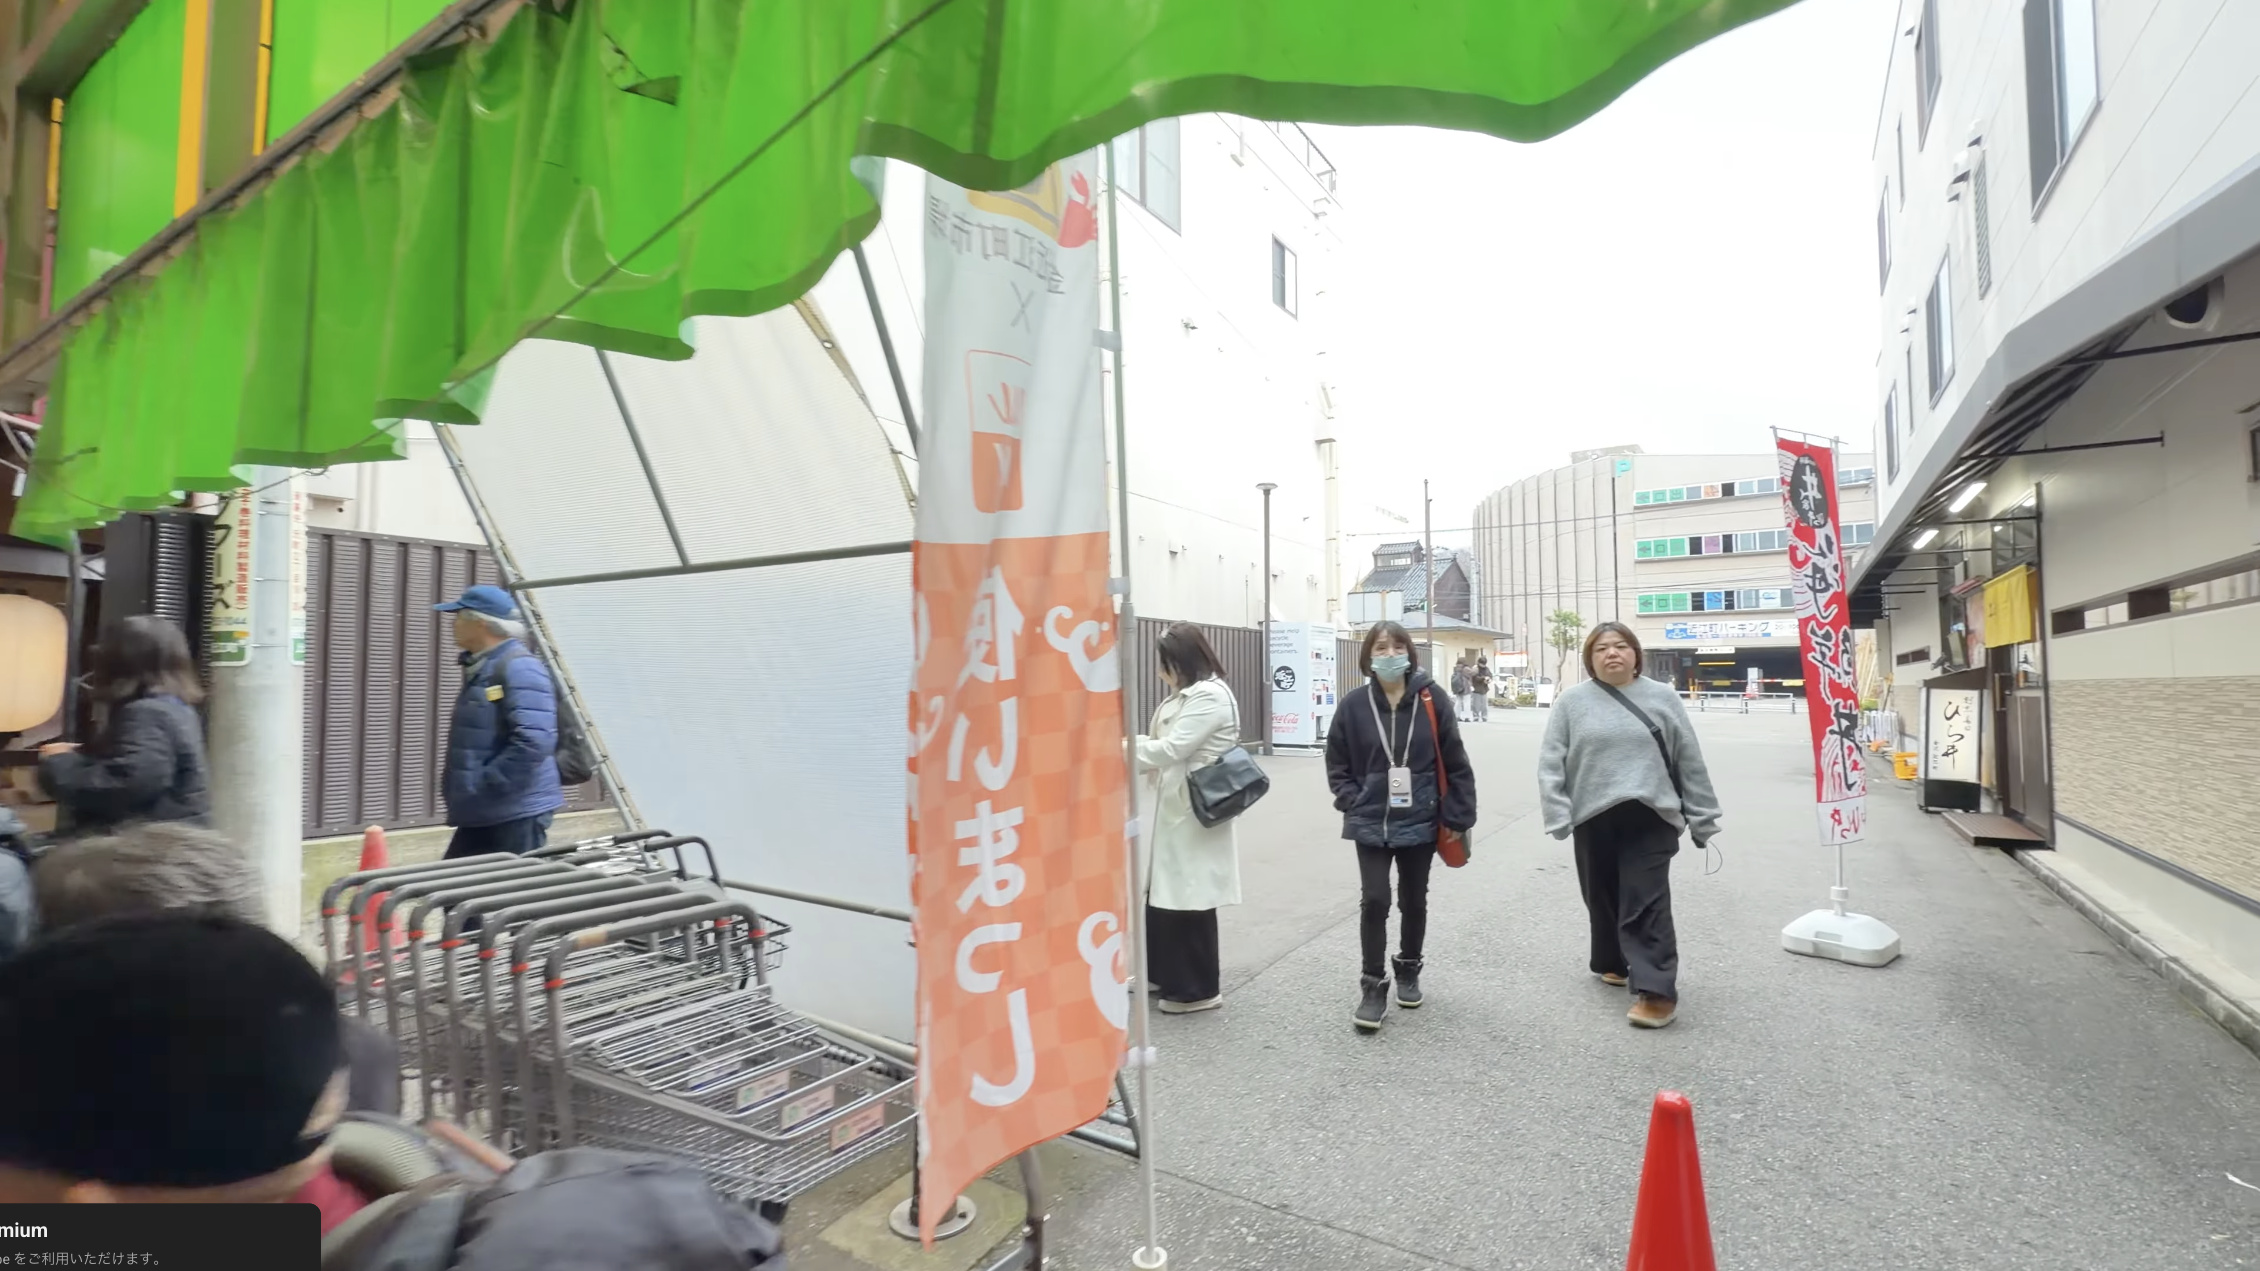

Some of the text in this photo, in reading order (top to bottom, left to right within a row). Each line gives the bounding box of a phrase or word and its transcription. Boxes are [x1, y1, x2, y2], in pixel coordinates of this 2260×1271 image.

[1688, 621, 1770, 634] 近江町パーキング
[1942, 700, 1965, 771] ひら井
